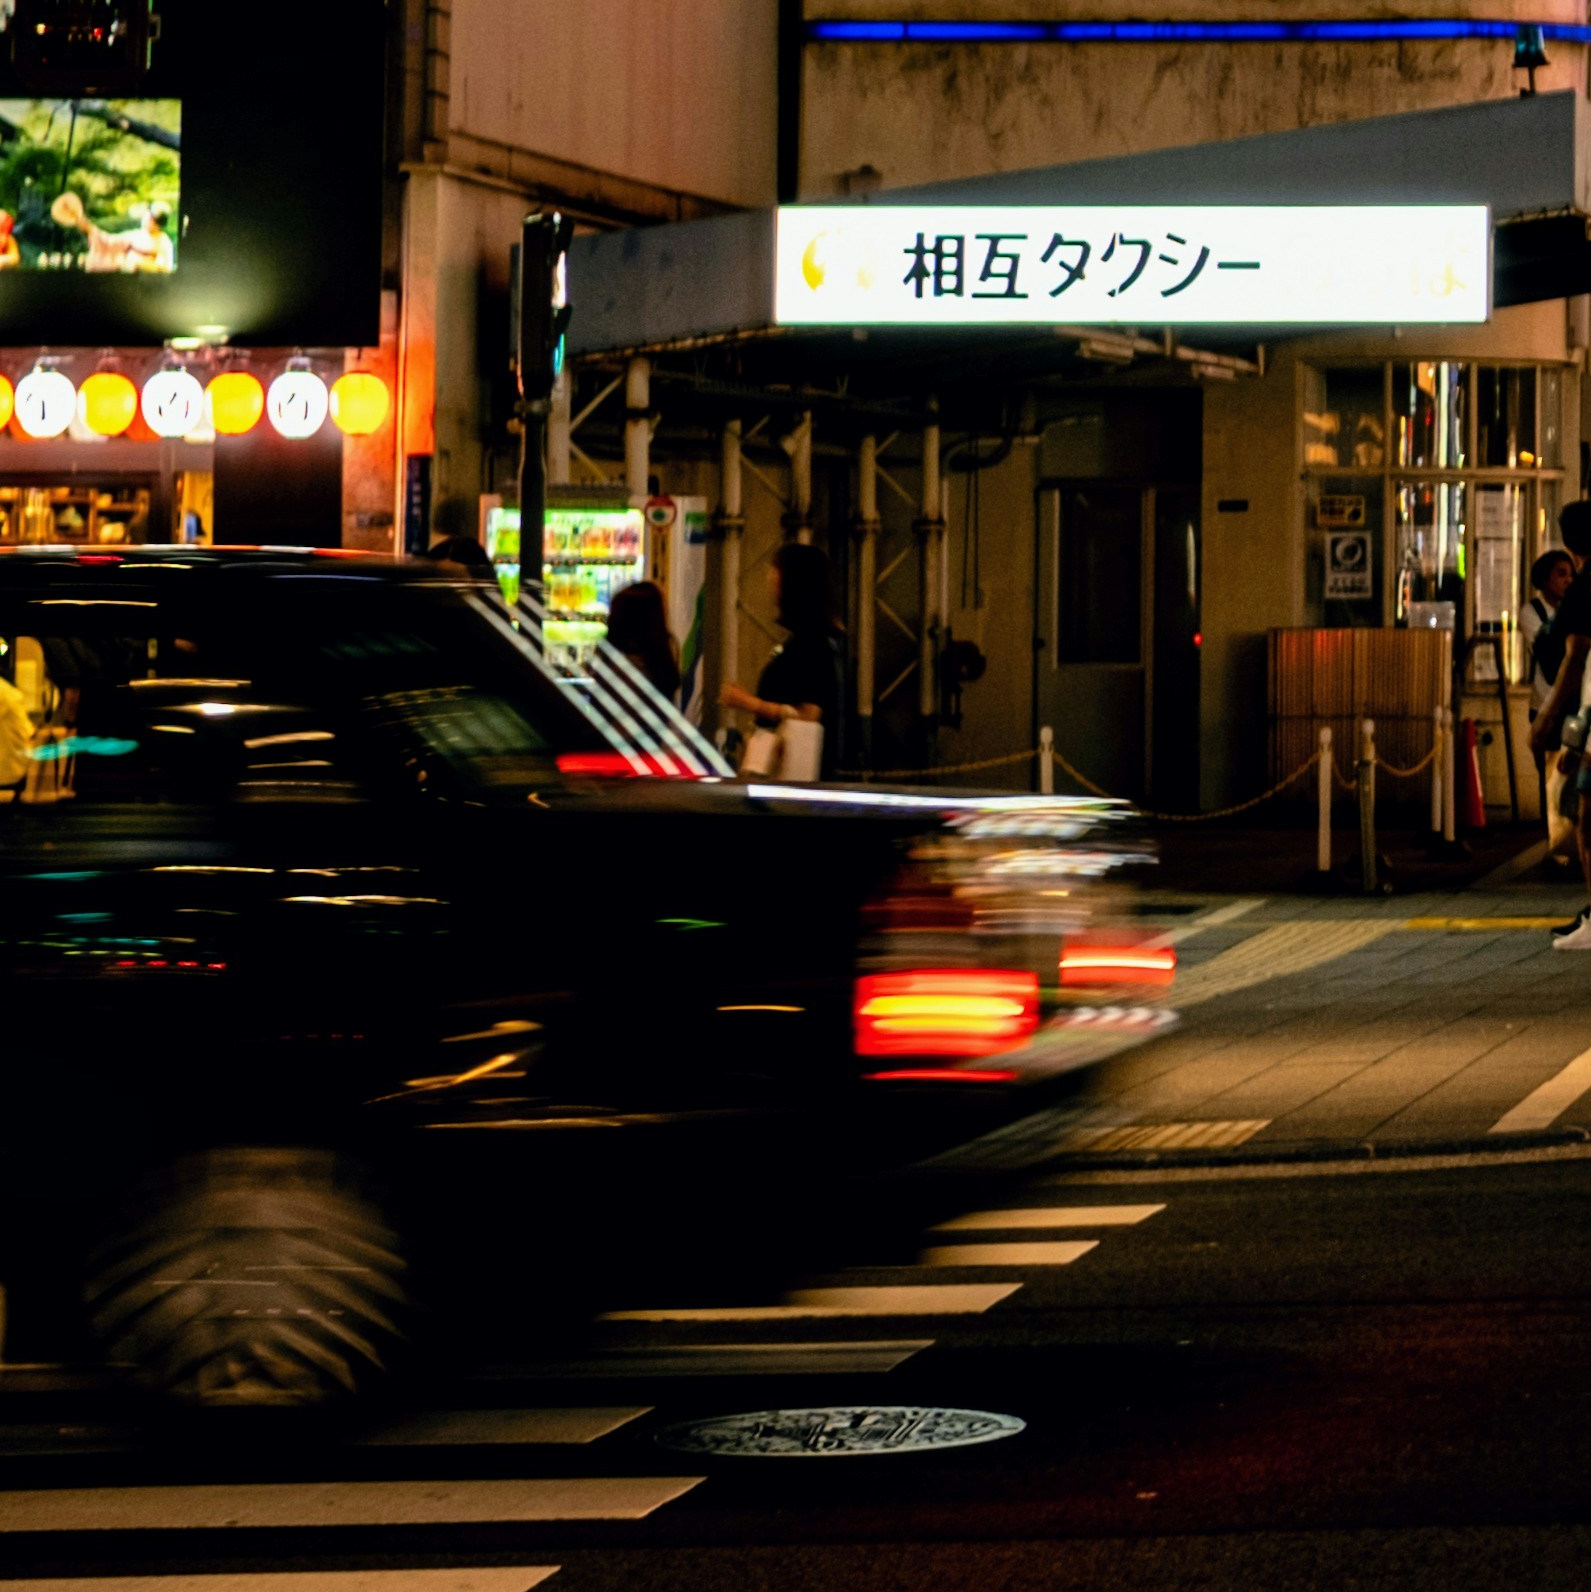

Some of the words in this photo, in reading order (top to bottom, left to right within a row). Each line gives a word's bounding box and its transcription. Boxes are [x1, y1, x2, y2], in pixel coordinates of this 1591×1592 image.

[903, 231, 1262, 300] 相互タクシー
